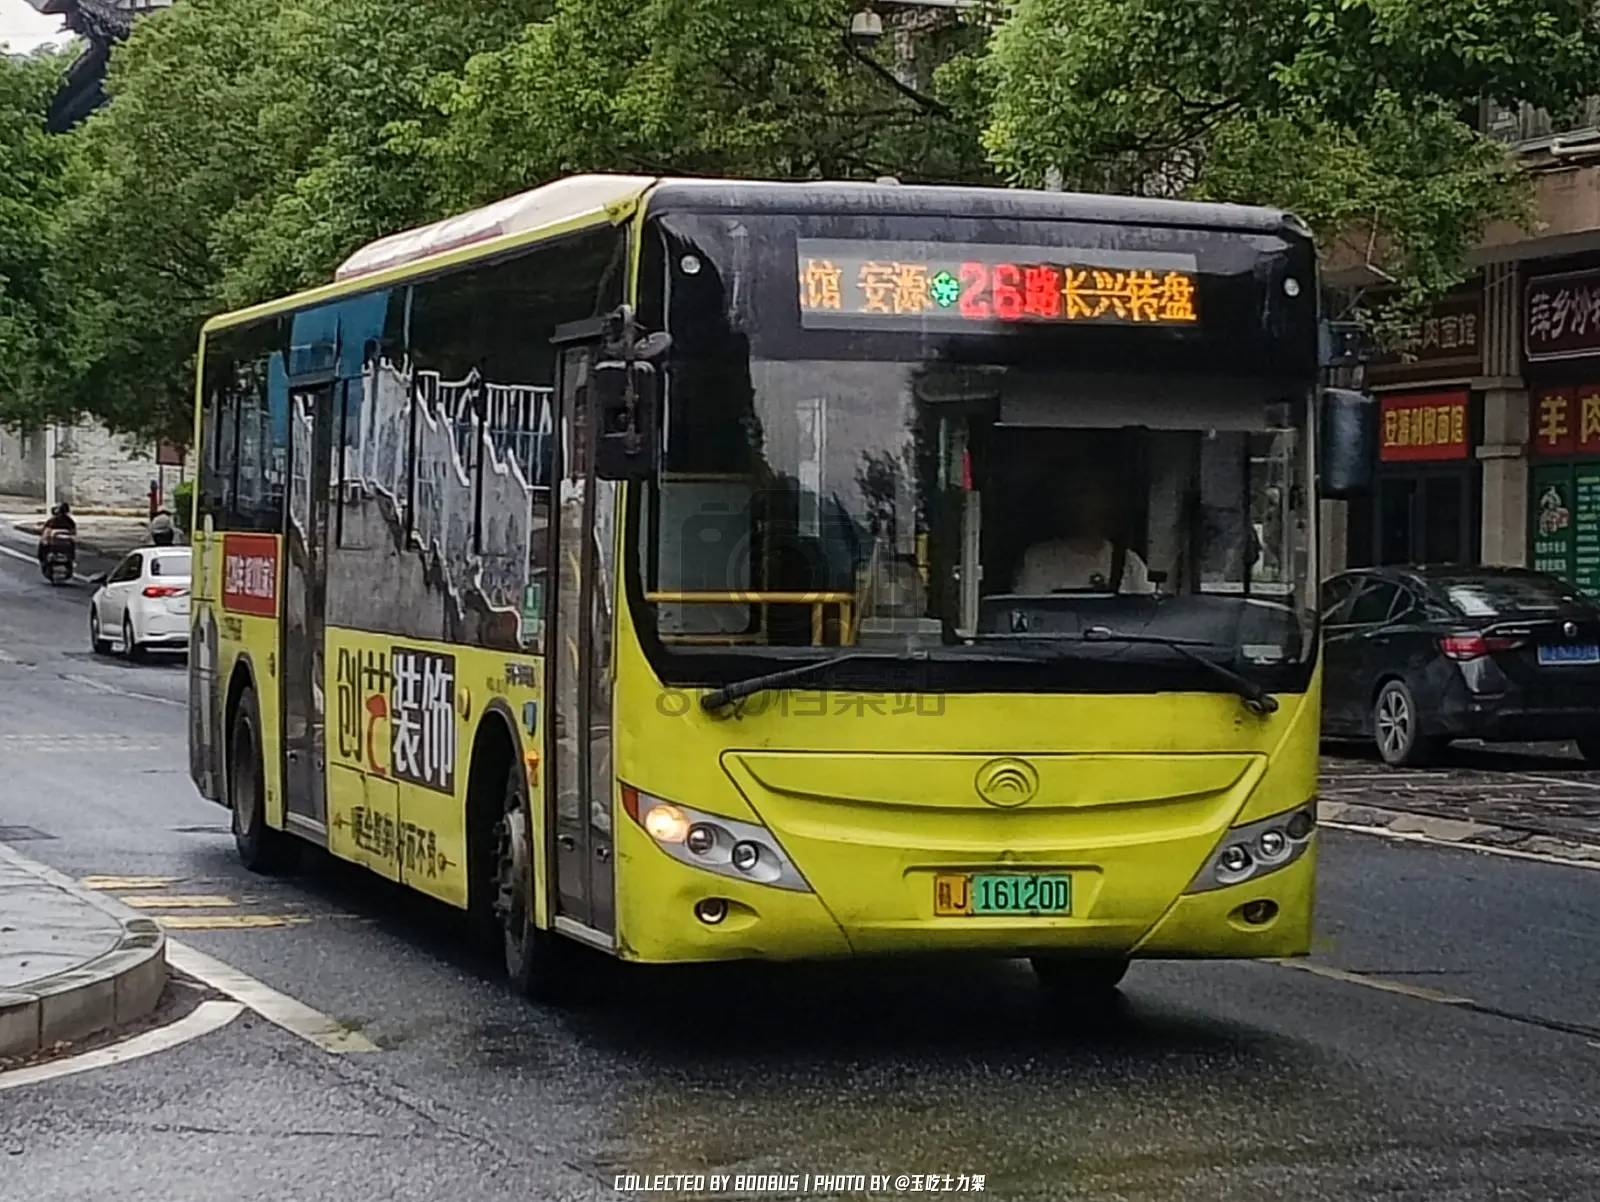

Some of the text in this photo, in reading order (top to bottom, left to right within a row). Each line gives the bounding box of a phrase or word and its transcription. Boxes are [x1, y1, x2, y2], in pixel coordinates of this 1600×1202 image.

[857, 260, 928, 315] 安源
[1062, 268, 1198, 322] 长兴转盘
